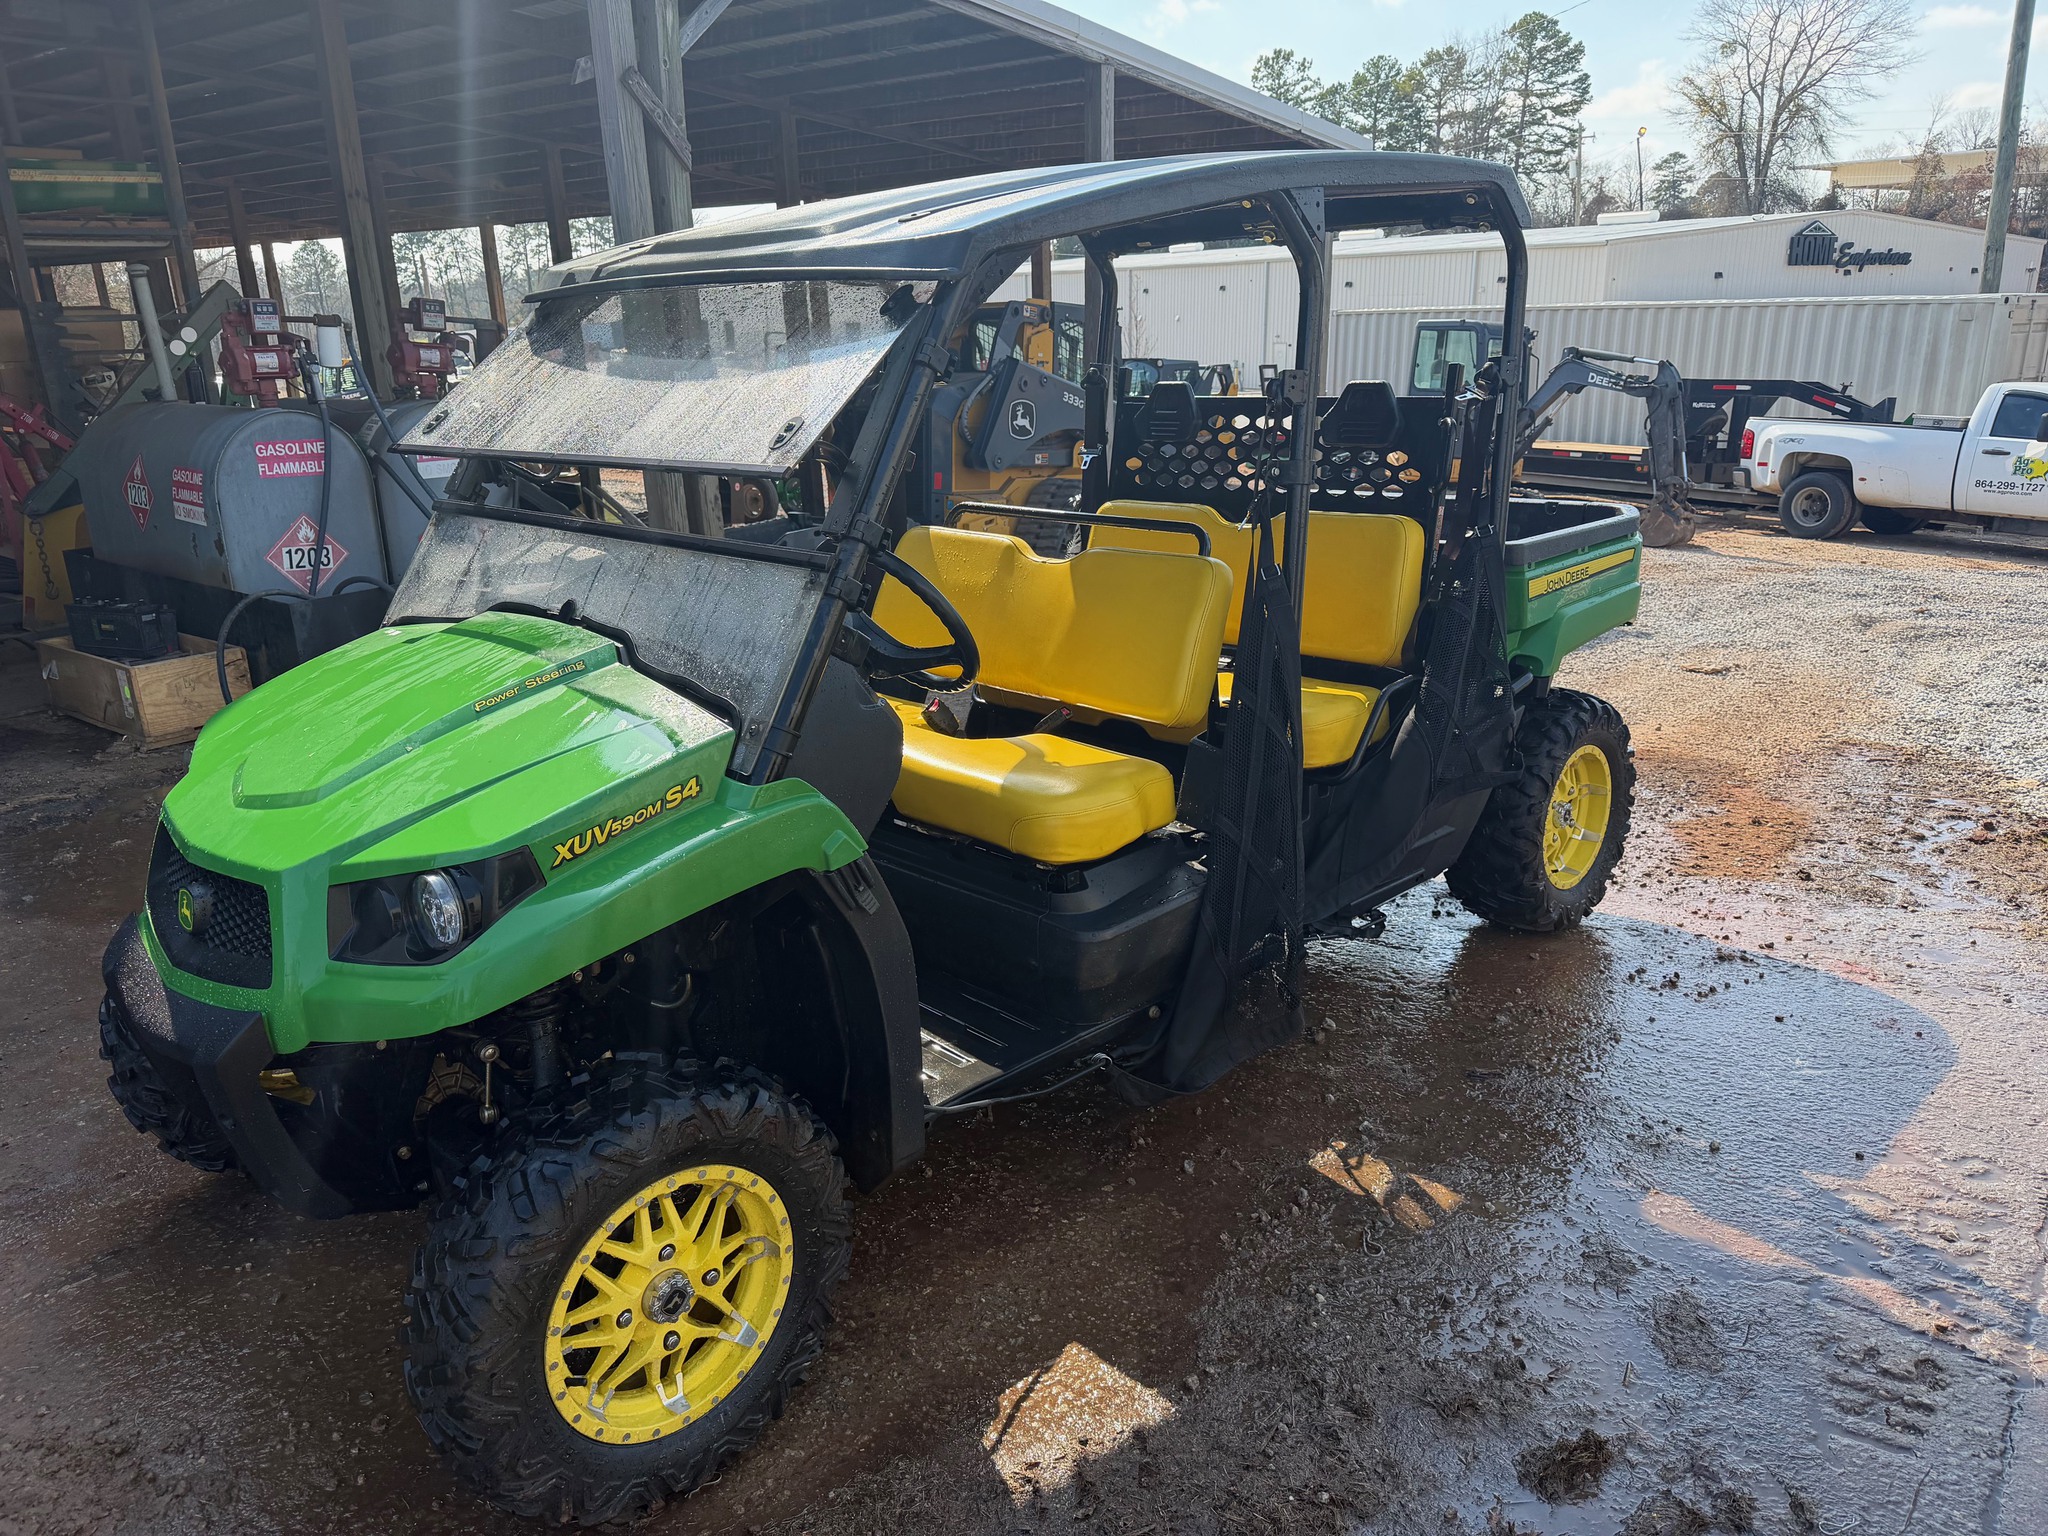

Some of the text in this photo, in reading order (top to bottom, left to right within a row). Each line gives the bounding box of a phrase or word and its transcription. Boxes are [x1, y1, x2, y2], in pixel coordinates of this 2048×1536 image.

[1789, 236, 1912, 272] HOME Emporium
[1062, 391, 1085, 409] 333G
[255, 442, 325, 457] GASOLINE
[172, 468, 204, 486] GASOLINE
[2012, 465, 2034, 476] Pro
[1974, 479, 2046, 493] 864-299-1727
[1983, 489, 2033, 497] www.agproco.com
[128, 484, 148, 507] 1203
[172, 487, 204, 504] FLAMMABLE
[138, 512, 144, 524] 3
[285, 546, 331, 570] 1203
[1543, 566, 1590, 594] JOHN DEERE
[474, 660, 586, 712] Power Steering
[551, 775, 702, 868] XUV590M S4
